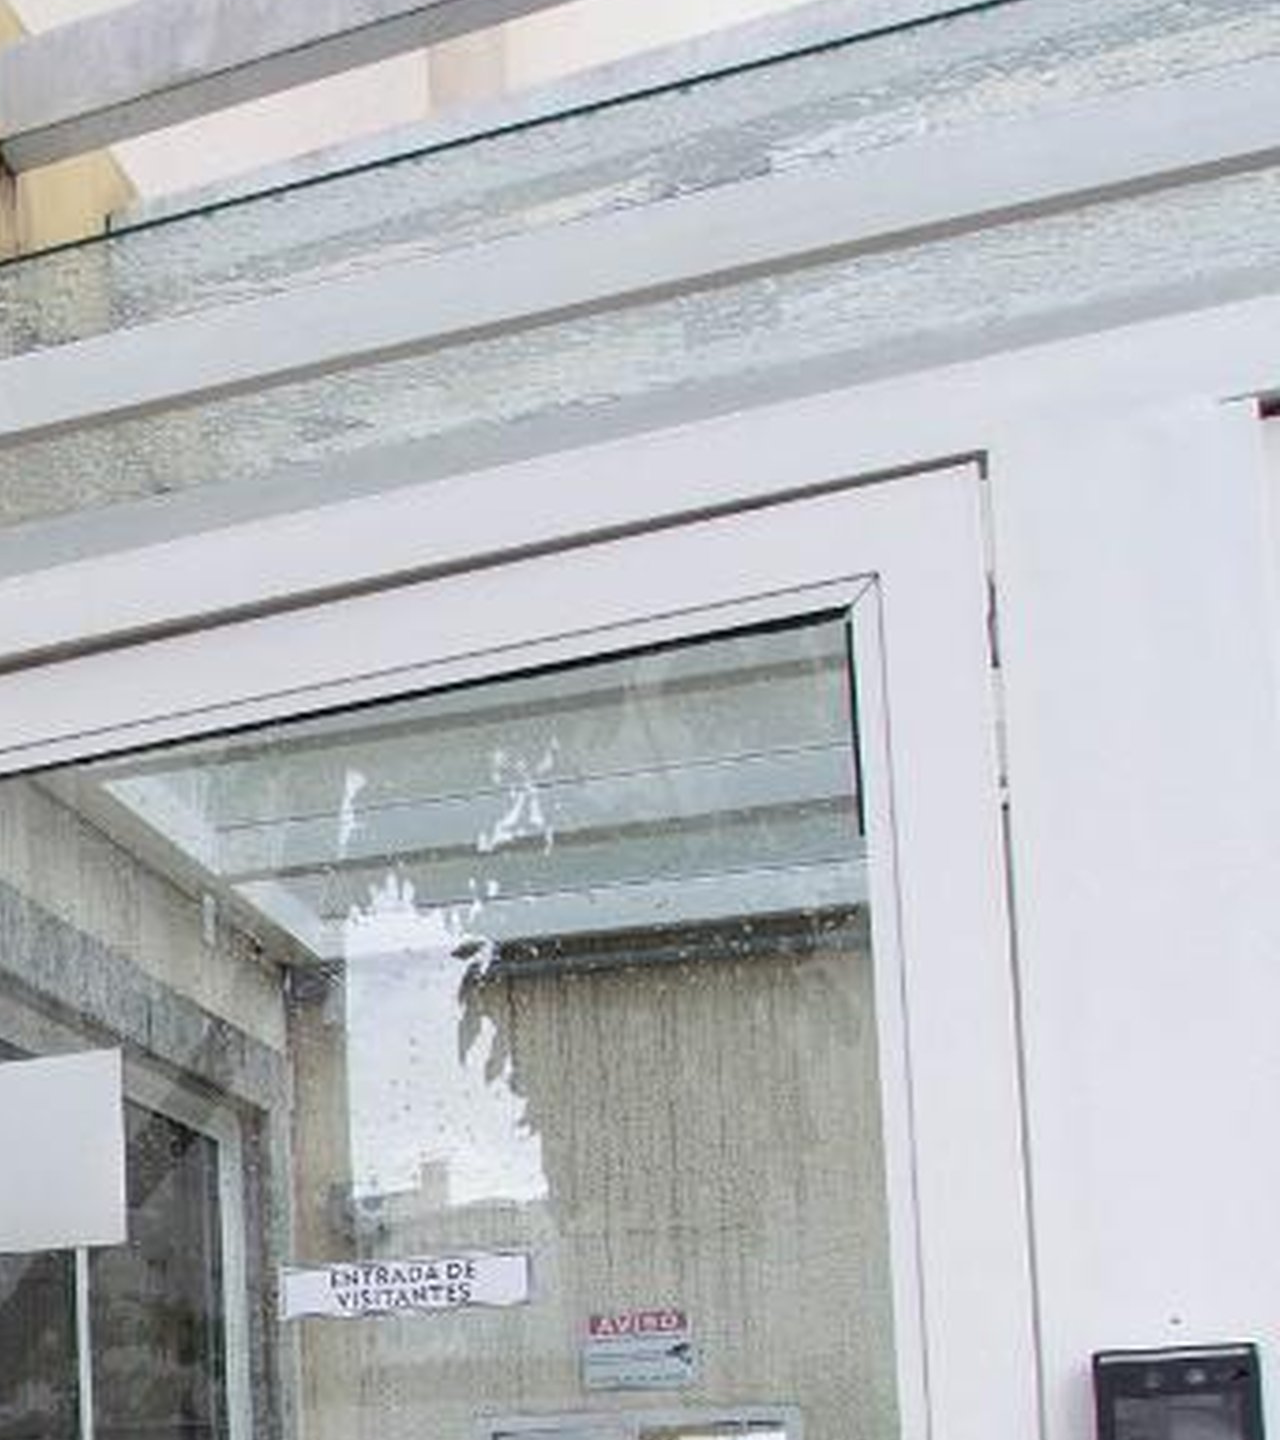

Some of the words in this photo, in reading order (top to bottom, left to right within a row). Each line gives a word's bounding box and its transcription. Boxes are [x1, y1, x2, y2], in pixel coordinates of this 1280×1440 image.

[330, 1266, 439, 1288] ENTRADA
[446, 1261, 476, 1282] DE
[338, 1283, 471, 1308] VISITANTES
